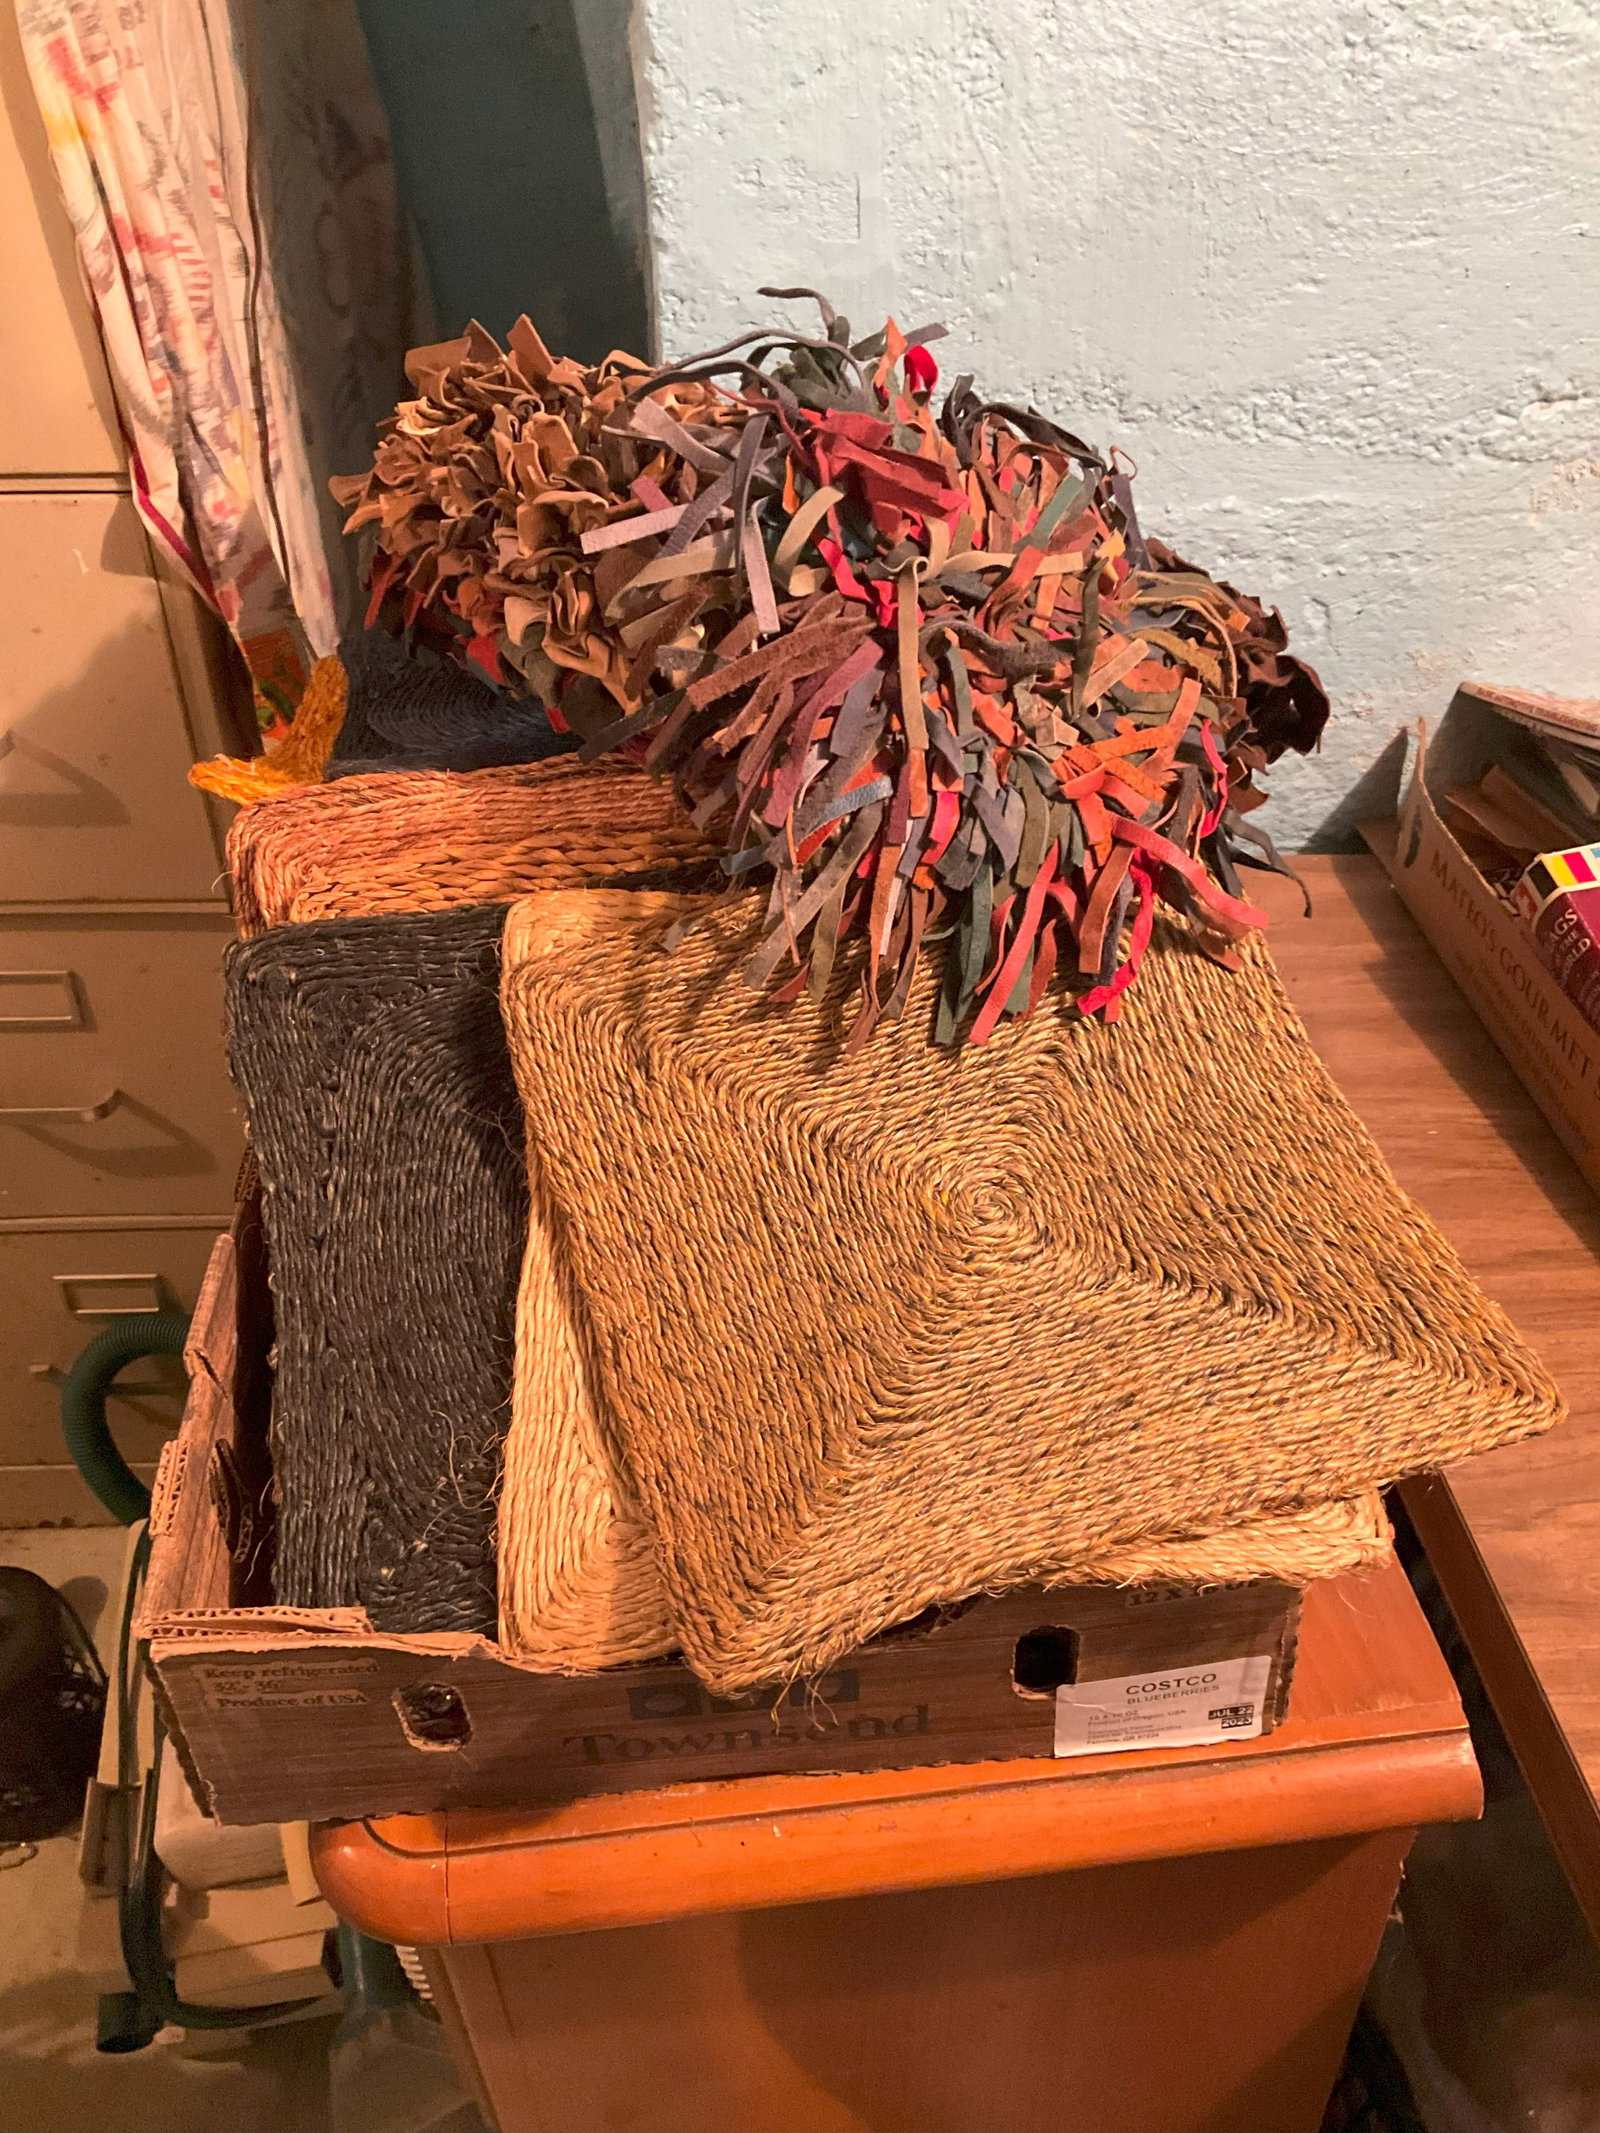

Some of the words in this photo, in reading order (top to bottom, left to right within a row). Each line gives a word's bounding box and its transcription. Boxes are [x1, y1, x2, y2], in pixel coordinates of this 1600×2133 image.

[1429, 850, 1497, 953] MATEO'S
[1499, 946, 1594, 1079] GOURMET
[204, 1668, 256, 1680] Keep
[261, 1664, 380, 1678] refrigerated
[1126, 1673, 1217, 1695] COSTCO
[303, 1695, 324, 1705] of
[327, 1694, 368, 1705] USA
[1127, 1684, 1220, 1705] BLUEBERRIES
[1209, 1708, 1235, 1719] JUL
[1238, 1705, 1254, 1715] 22
[1221, 1716, 1252, 1727] 2023
[561, 1703, 930, 1764] Townsend
